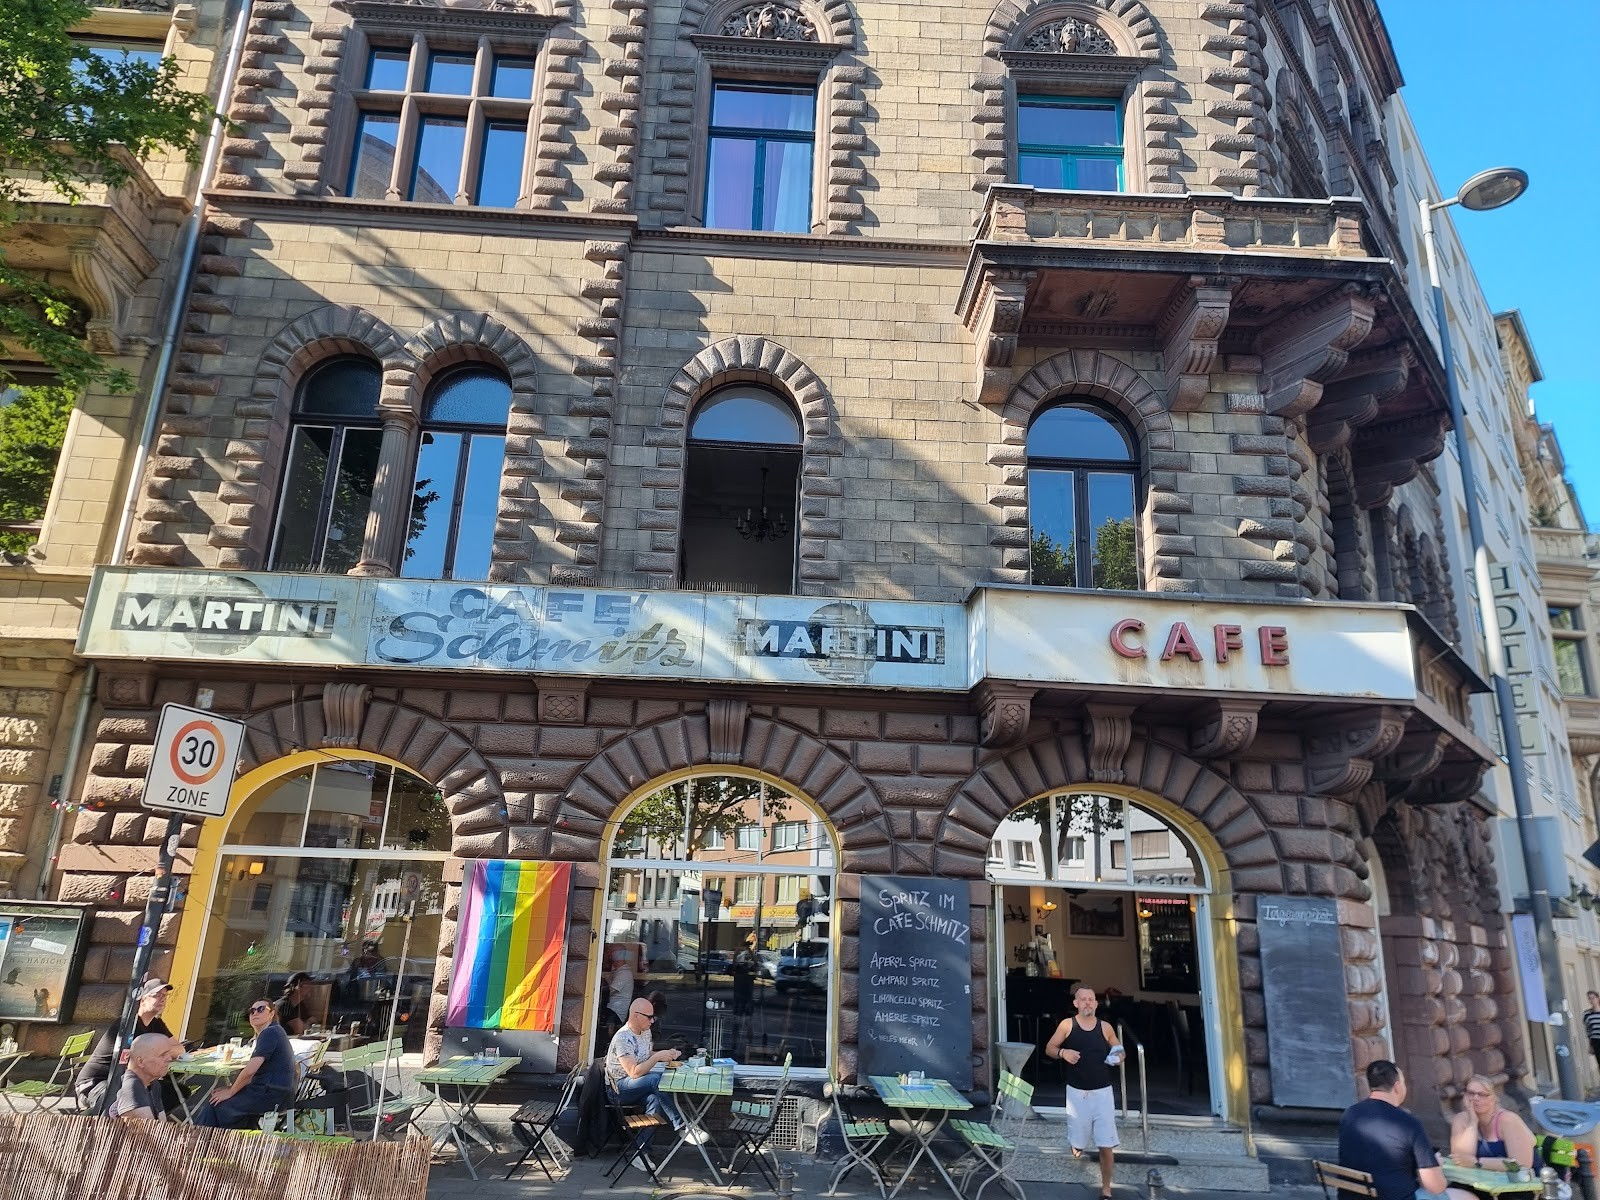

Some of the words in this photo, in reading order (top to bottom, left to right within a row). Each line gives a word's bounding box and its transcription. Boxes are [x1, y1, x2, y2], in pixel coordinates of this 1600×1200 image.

[119, 597, 325, 637] MARTINI
[745, 624, 937, 660] MARTINI
[1110, 618, 1290, 667] CAFE
[181, 736, 215, 768] 30
[166, 785, 210, 807] ZONE
[879, 889, 930, 914] SPRITZ
[938, 893, 955, 911] IM
[873, 912, 913, 935] CAFE
[915, 911, 970, 945] SCHMITZ
[870, 951, 906, 969] APEROL
[908, 956, 938, 971] SPRITZ
[870, 974, 908, 986] CAMPARI
[911, 976, 940, 988] SPRITZ
[870, 993, 917, 1005] LIMONCELLO
[918, 997, 945, 1010] SPRITZ
[911, 1014, 941, 1027] SPRITZ
